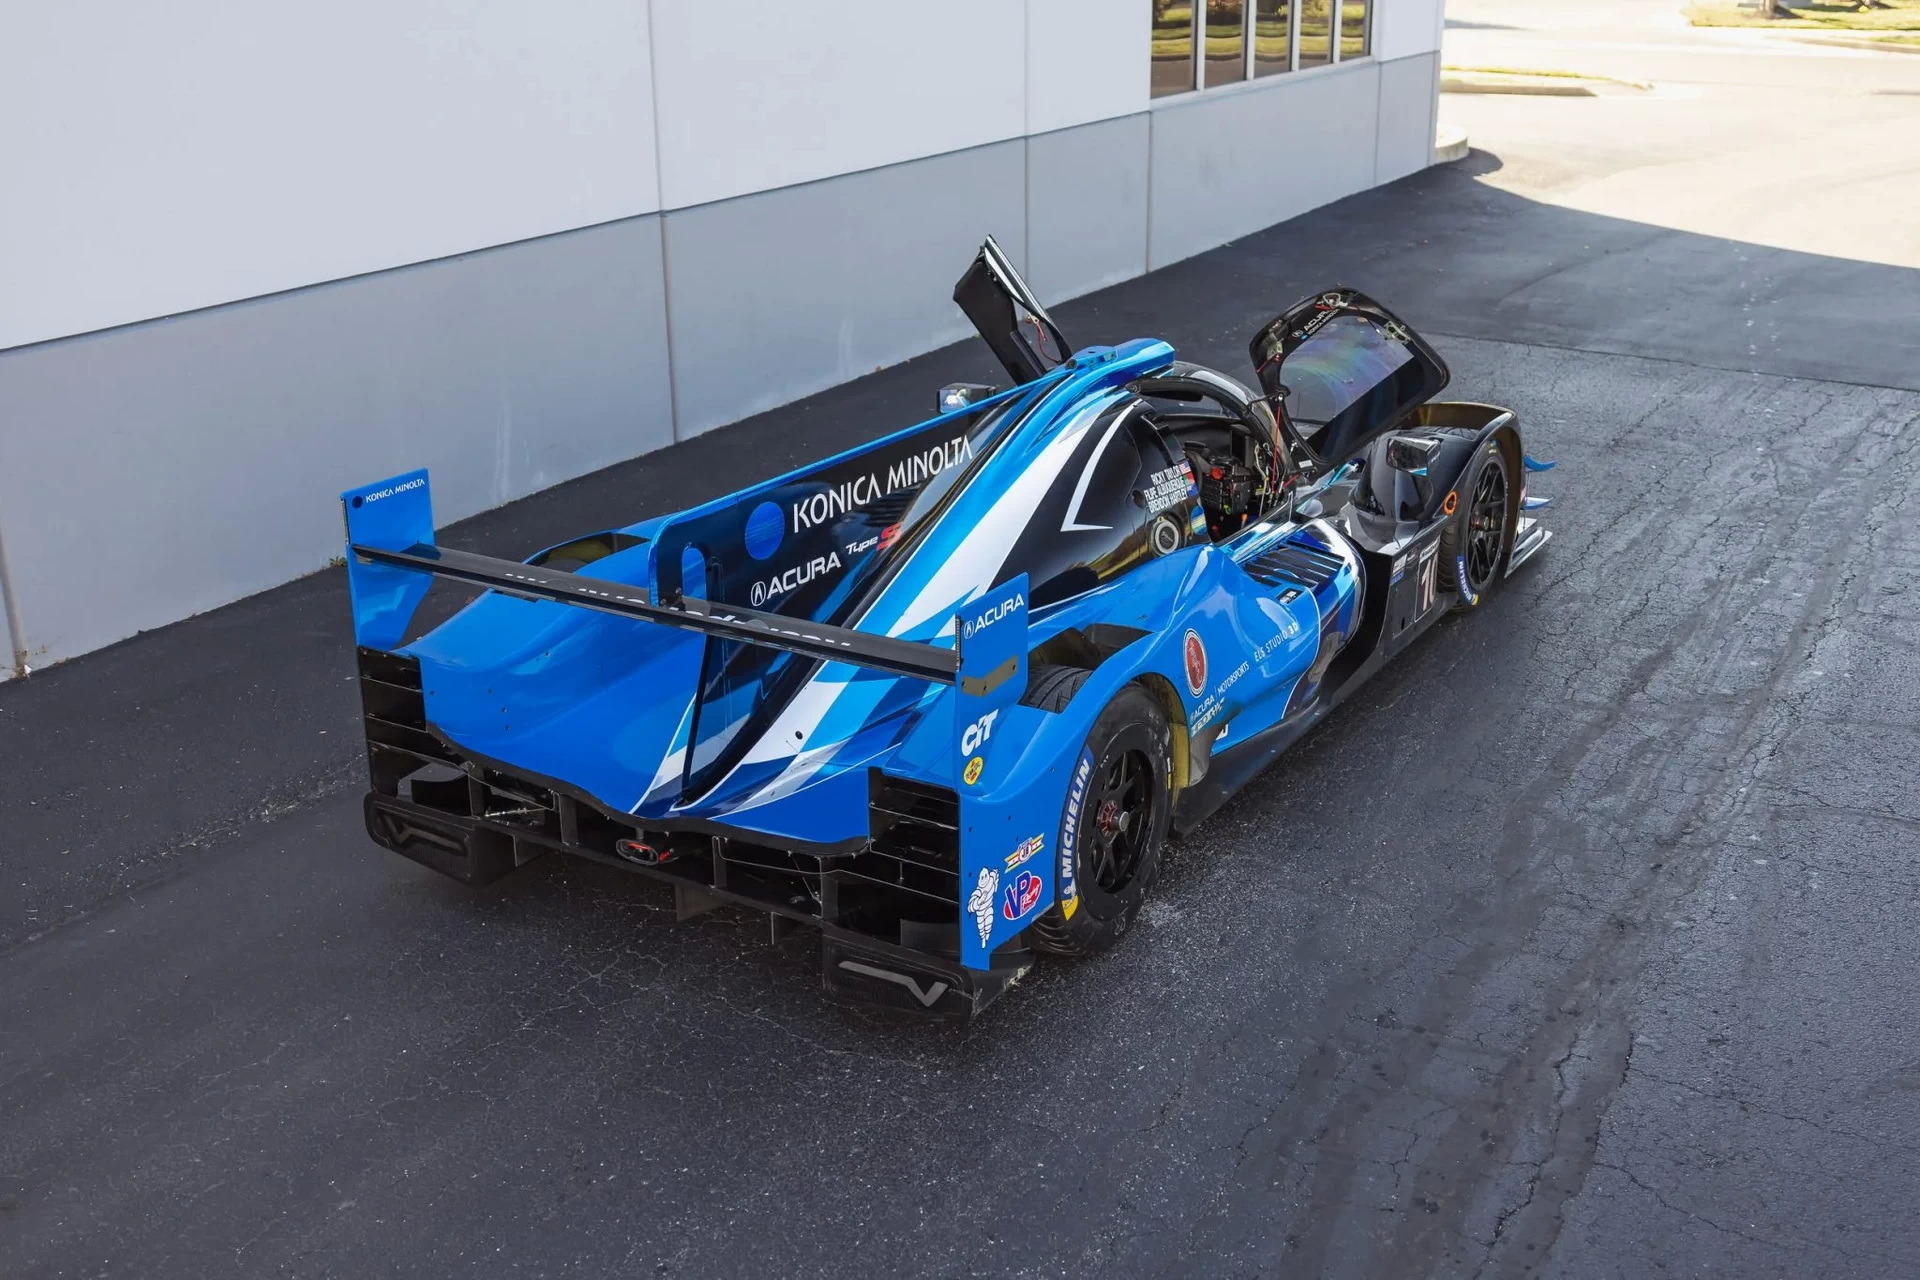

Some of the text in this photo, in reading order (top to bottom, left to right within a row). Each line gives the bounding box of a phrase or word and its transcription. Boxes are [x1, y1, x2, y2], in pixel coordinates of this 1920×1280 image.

[1304, 310, 1330, 331] ACUR
[365, 478, 425, 503] KONICA MINOLTA
[793, 435, 973, 533] KONICA MINOLTA
[767, 551, 841, 599] ACURA
[974, 593, 1025, 634] ACURA
[1062, 758, 1091, 878] MICHELIN
